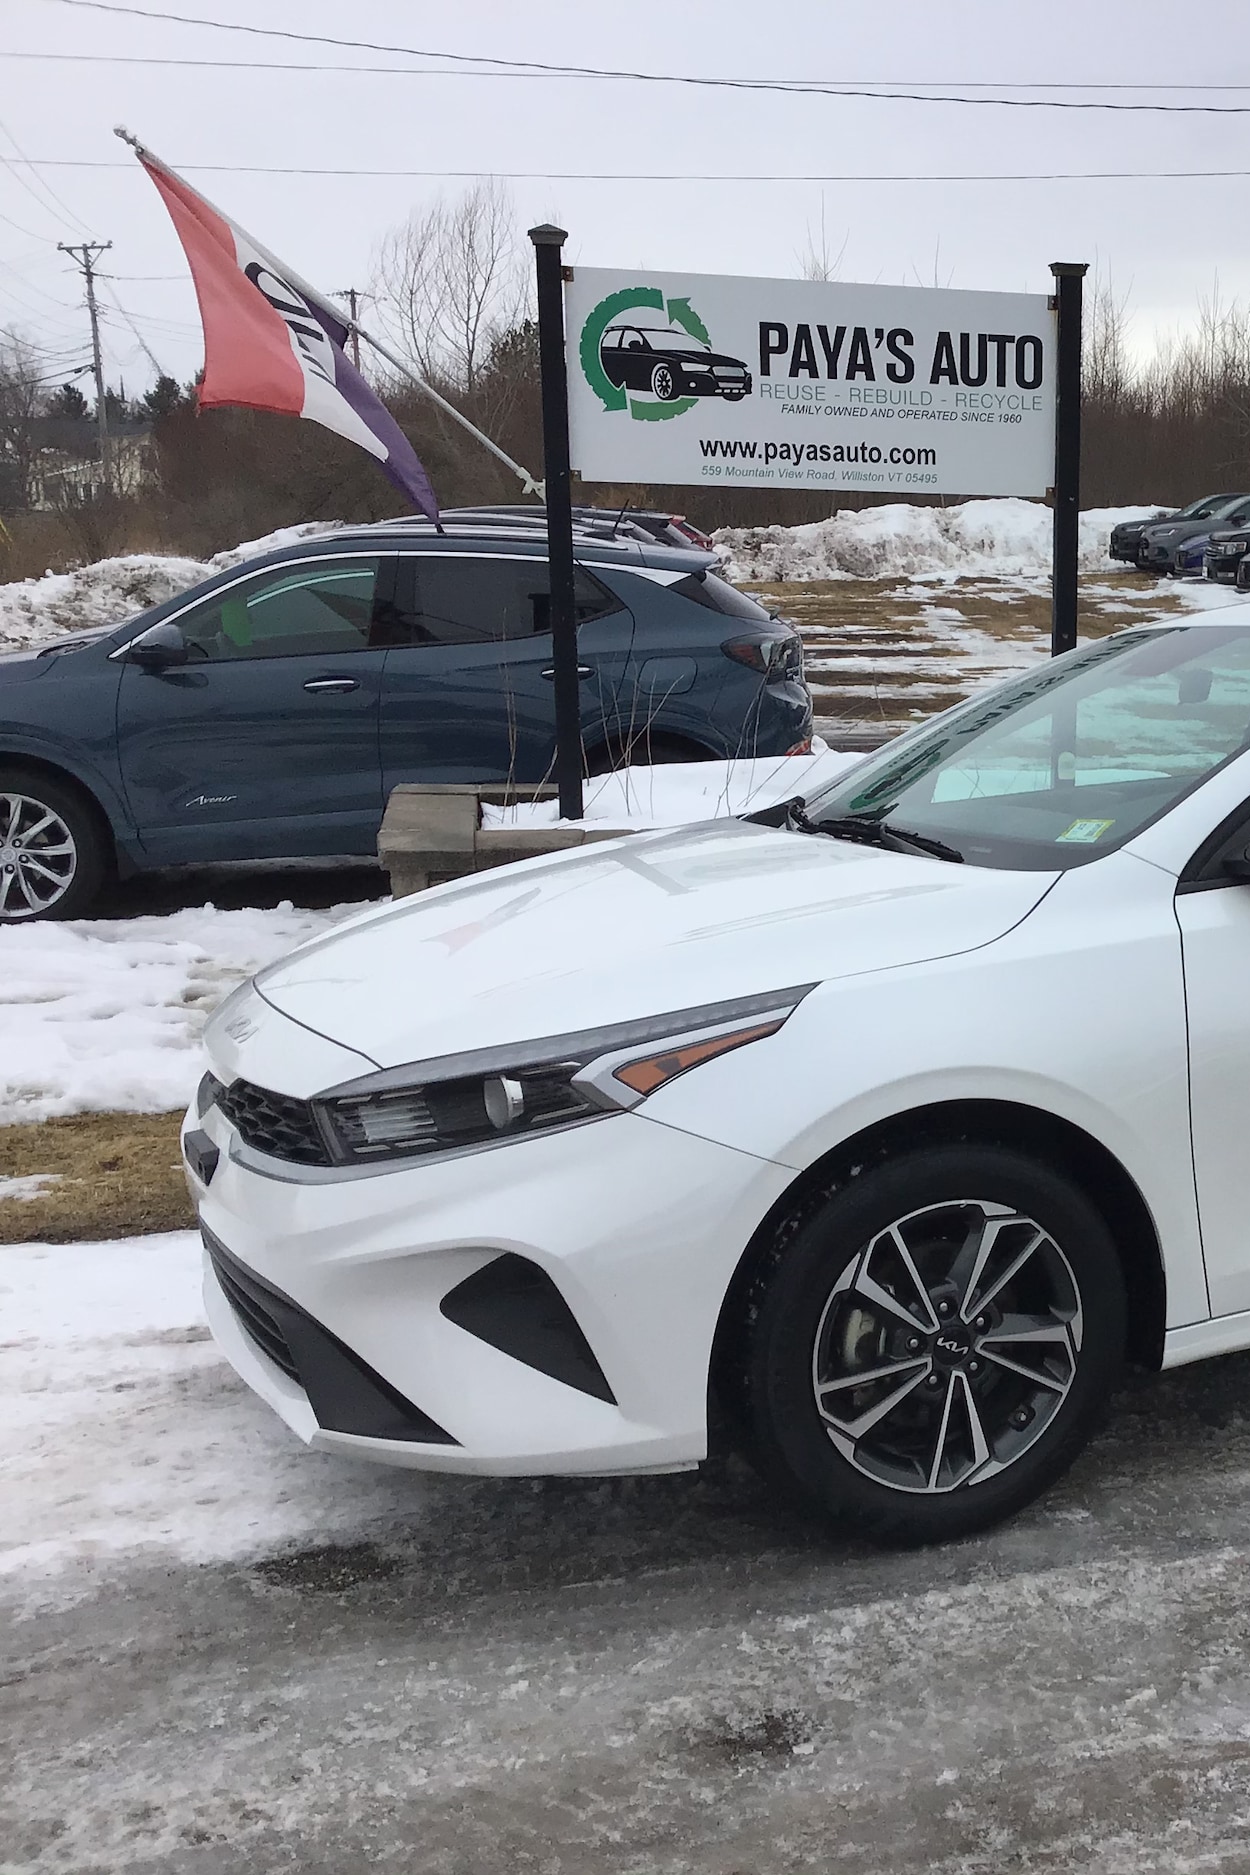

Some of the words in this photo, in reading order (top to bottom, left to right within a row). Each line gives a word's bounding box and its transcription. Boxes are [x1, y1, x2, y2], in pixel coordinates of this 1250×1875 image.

[759, 321, 915, 384] PAYA'S
[929, 331, 1043, 390] AUTO
[760, 383, 826, 401] REUSE
[849, 387, 933, 406] REBUILD
[955, 392, 1043, 411] RECYCLE
[781, 403, 821, 415] FAMILY
[824, 406, 868, 417] OWNED
[870, 408, 895, 418] AND
[897, 409, 958, 421] OPERATED
[961, 411, 994, 423] SINCE
[998, 413, 1022, 424] 1960
[699, 439, 936, 466] www.payasauto.com
[701, 465, 722, 476] 559
[725, 466, 775, 478] Mountain
[778, 468, 803, 479] View
[841, 470, 884, 482] Williston
[888, 472, 903, 482] VT
[905, 472, 938, 483] 05495
